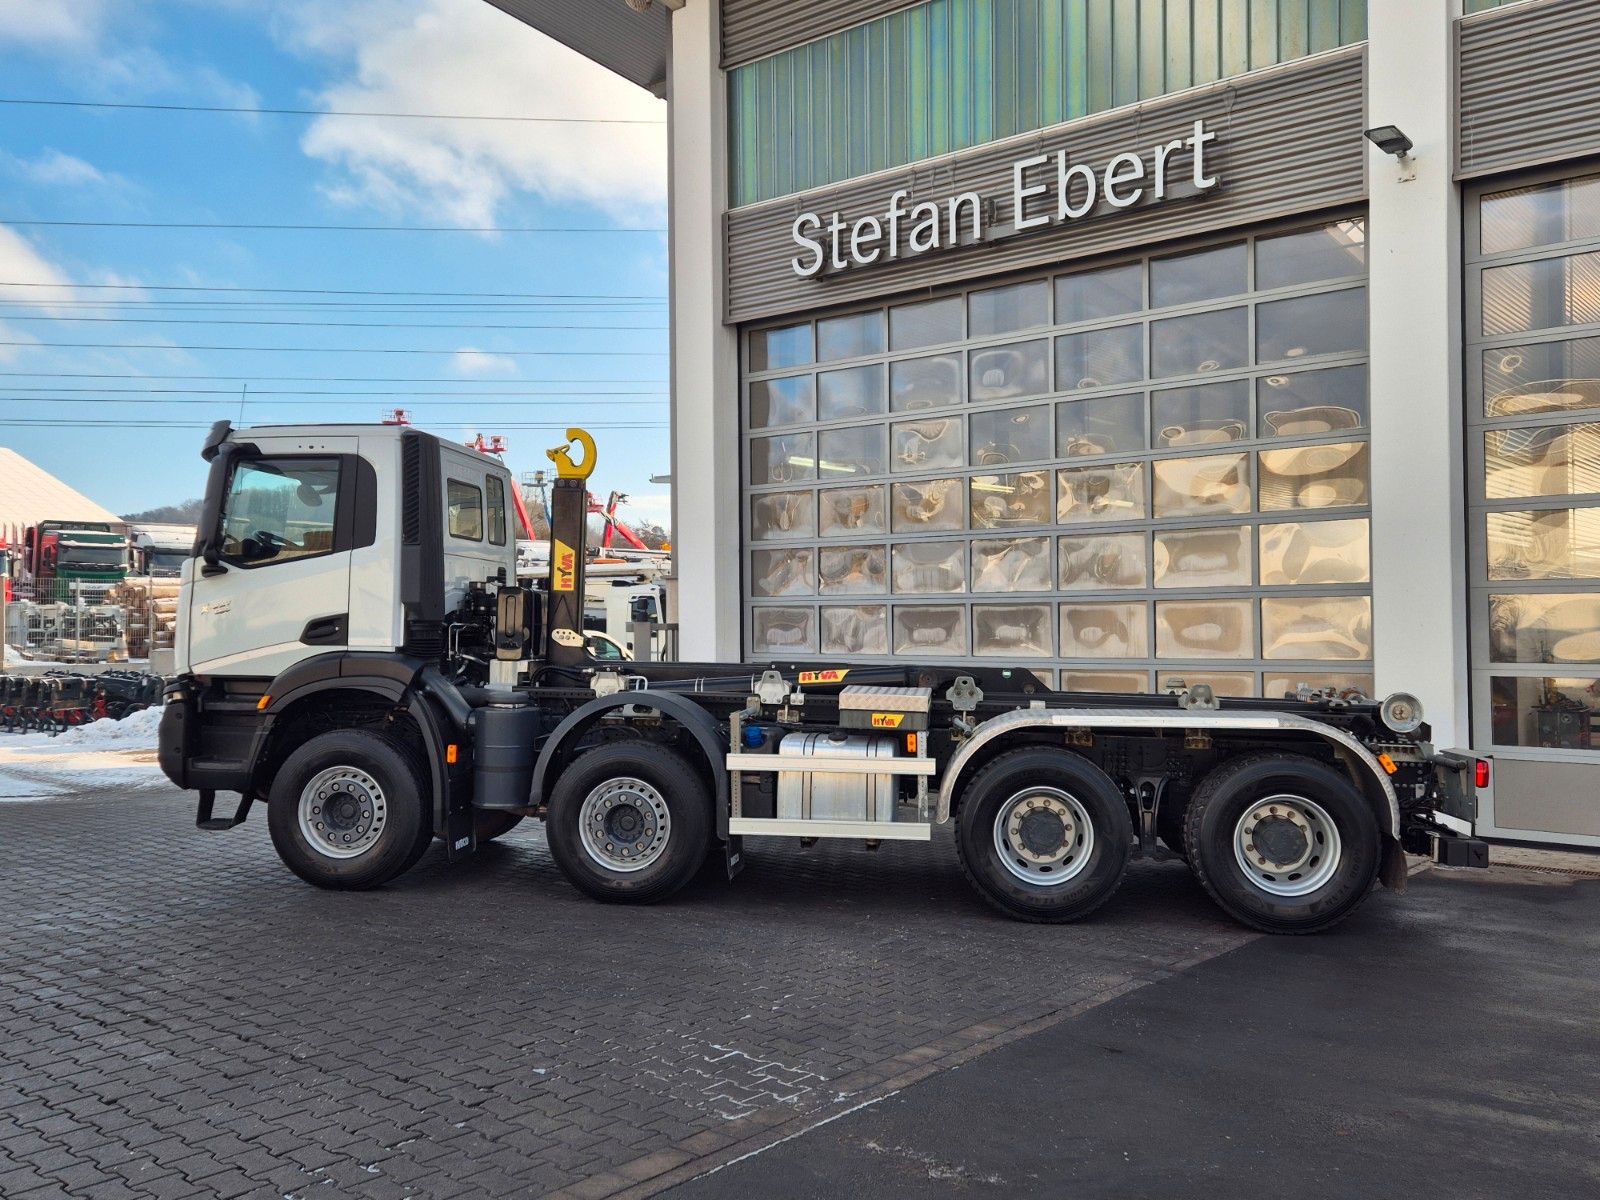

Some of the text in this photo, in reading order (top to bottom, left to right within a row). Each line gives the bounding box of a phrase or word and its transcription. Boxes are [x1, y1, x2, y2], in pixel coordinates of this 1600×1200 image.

[790, 119, 1218, 277] Stefan Ebert
[557, 553, 573, 589] HYVA
[801, 671, 839, 681] HYVA
[873, 716, 896, 727] HYVA
